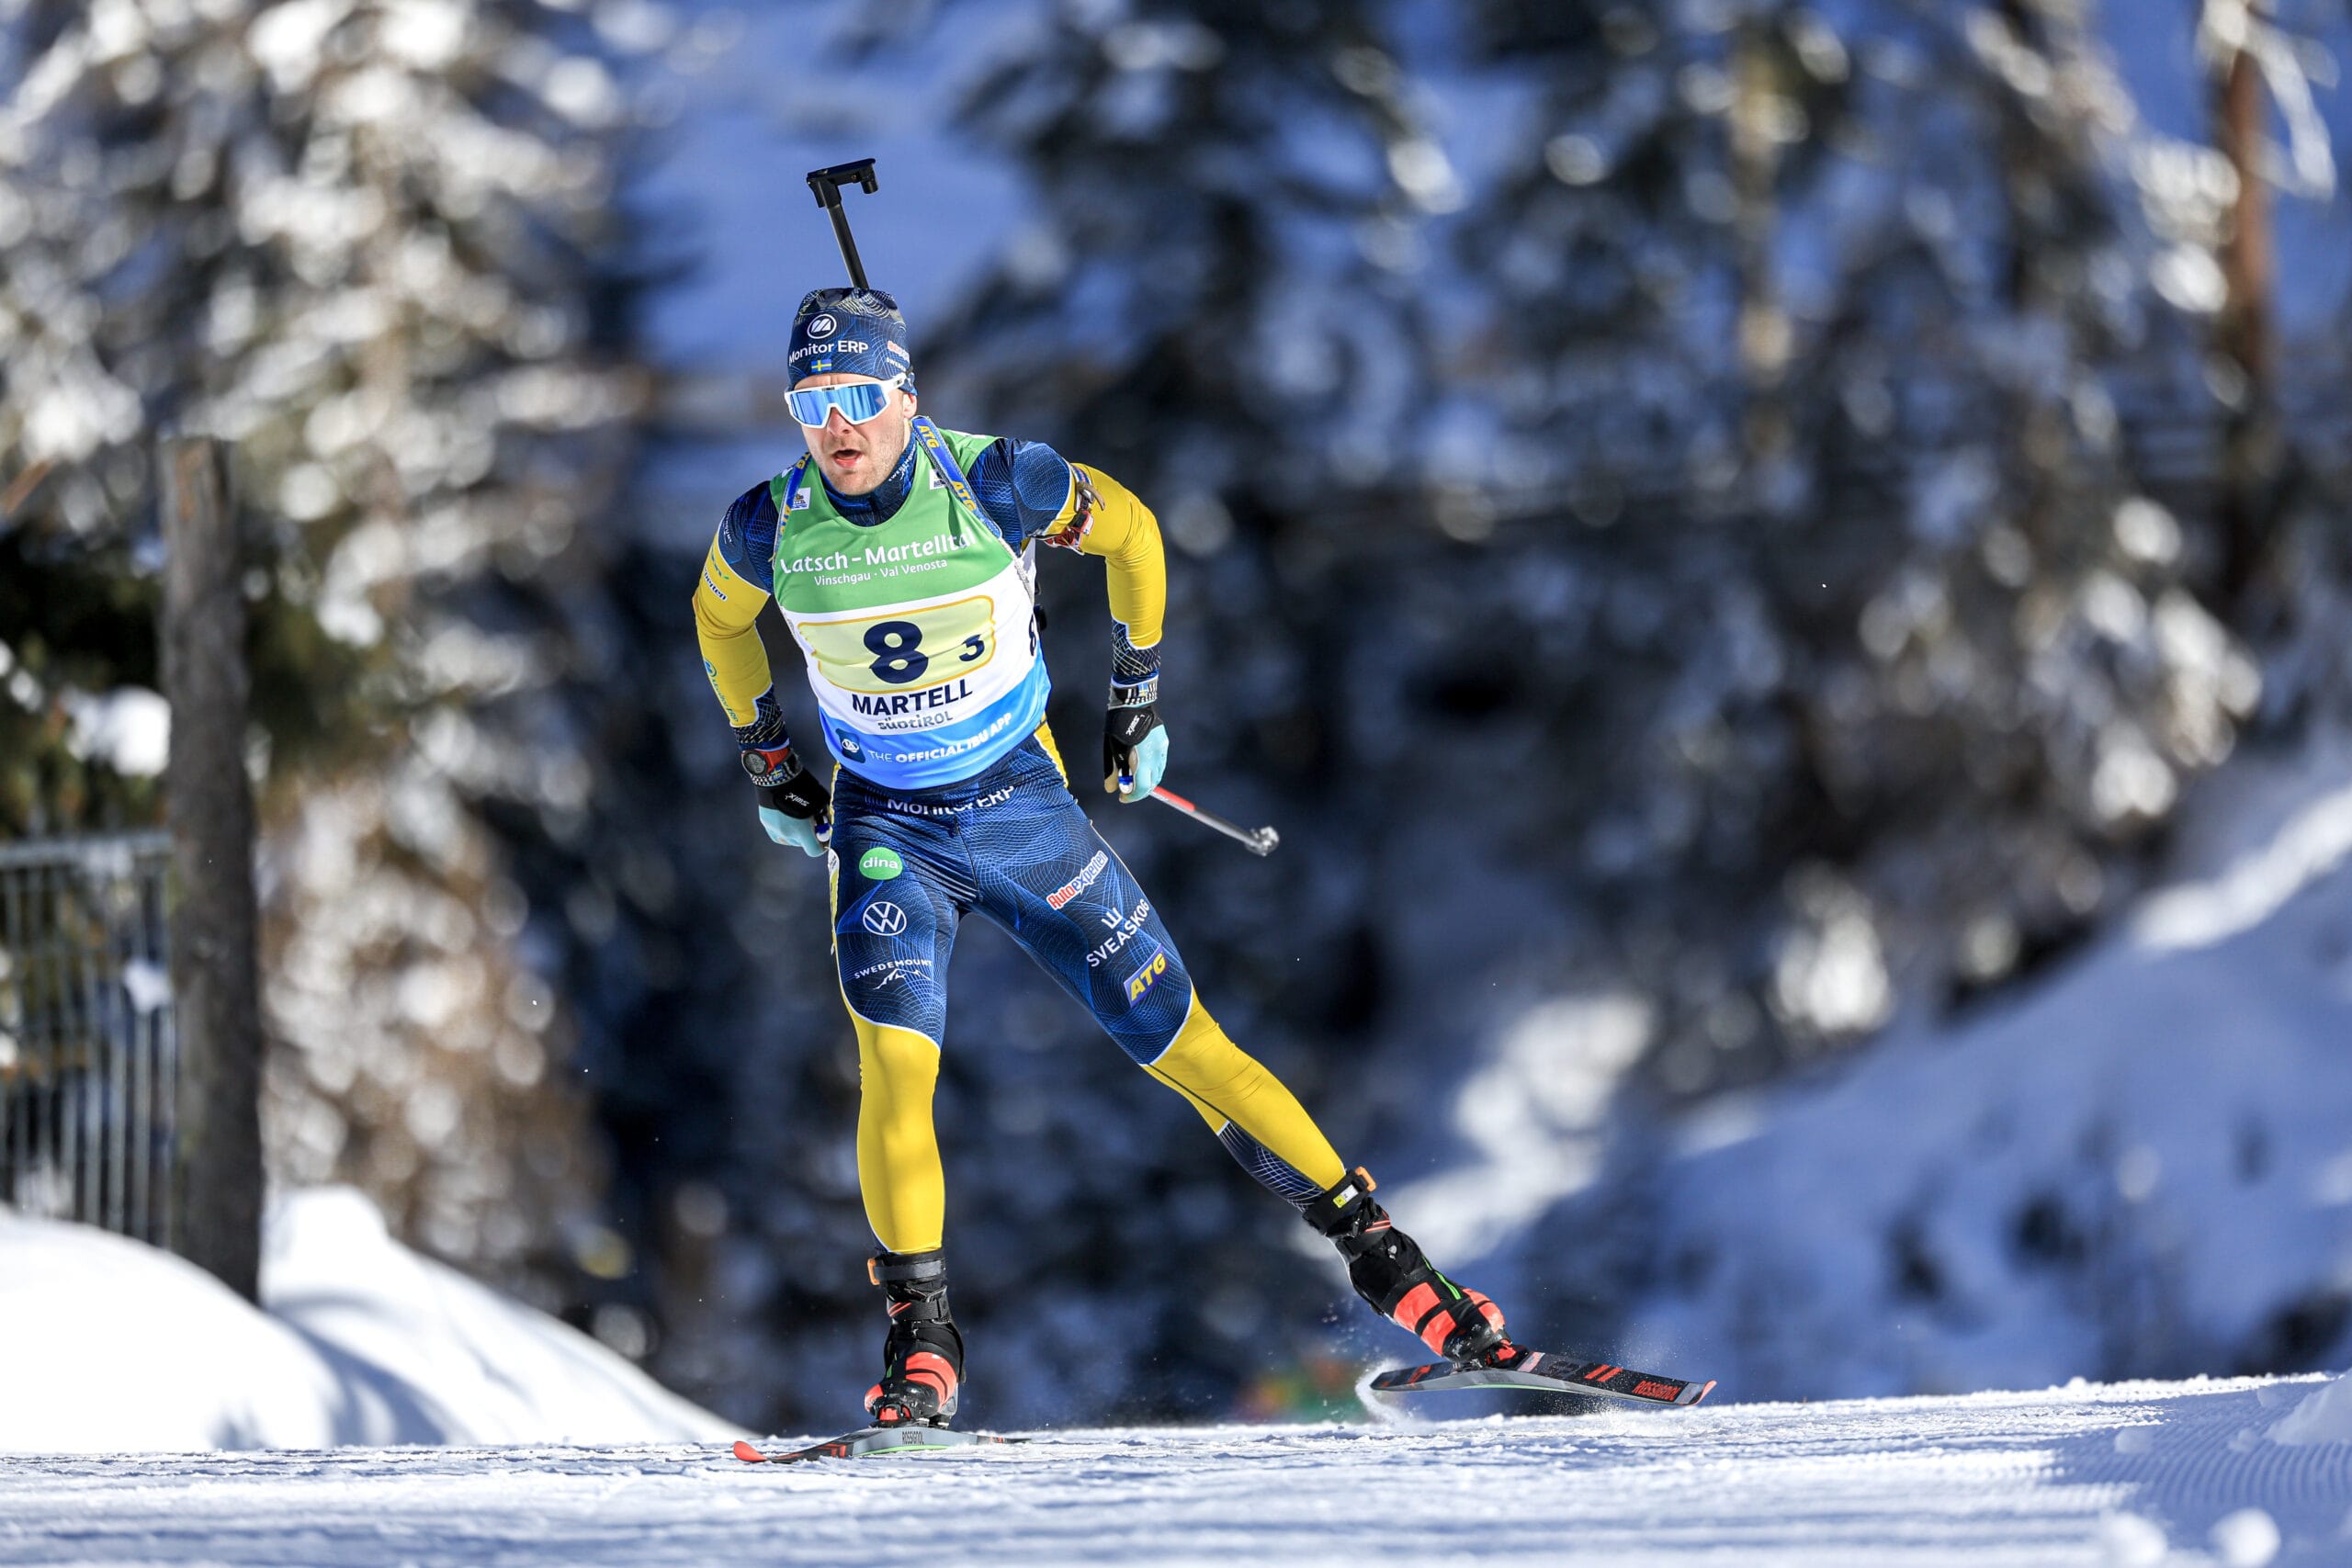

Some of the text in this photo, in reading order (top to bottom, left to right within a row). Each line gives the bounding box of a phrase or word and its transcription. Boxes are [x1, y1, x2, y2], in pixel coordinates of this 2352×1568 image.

[789, 343, 834, 367] Monitor
[838, 340, 869, 354] ERP
[814, 573, 871, 587] Vinschgau
[880, 565, 899, 578] Val
[900, 558, 947, 575] Venosta
[864, 621, 929, 683] 8
[958, 634, 985, 661] 3
[852, 679, 973, 716] MARTELL
[867, 713, 1012, 763] THE OFFICIAL IBU APP
[863, 856, 899, 870] dina
[1046, 851, 1108, 910] Autoexperten
[1086, 898, 1150, 967] SVEASKOG
[854, 959, 933, 979] SWEDEMOUNT
[1130, 953, 1166, 1001] ATG
